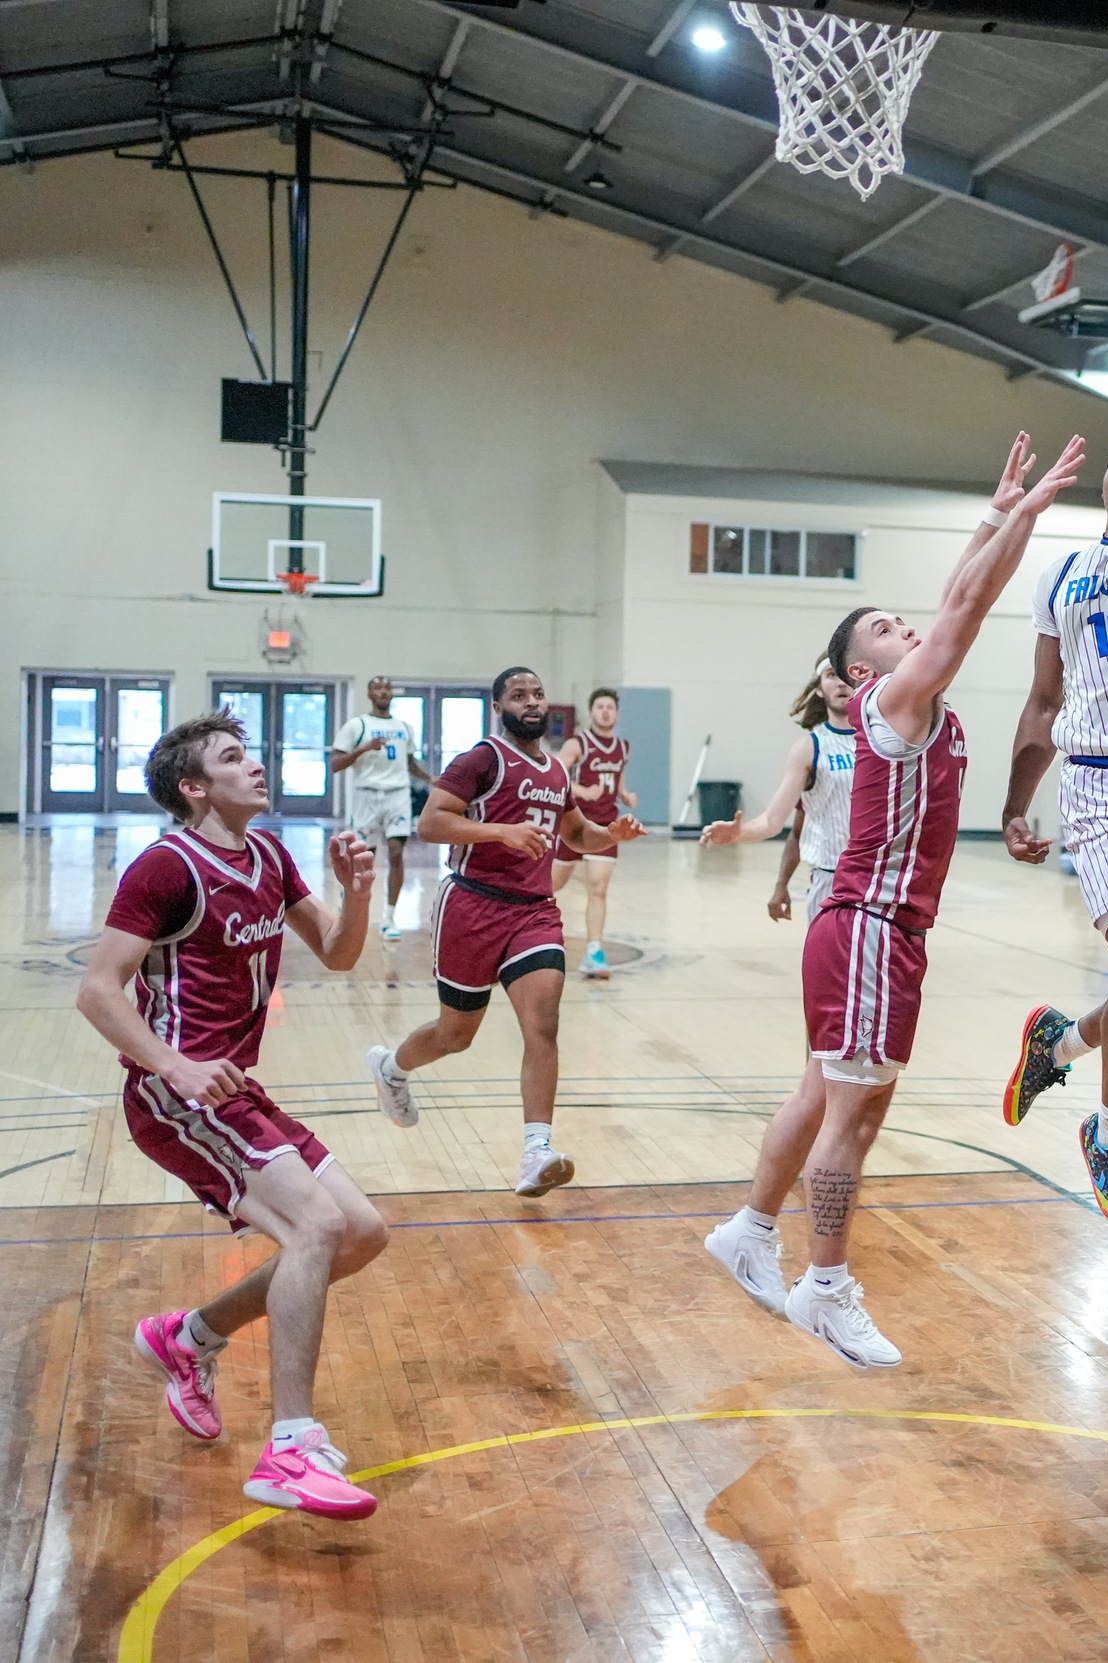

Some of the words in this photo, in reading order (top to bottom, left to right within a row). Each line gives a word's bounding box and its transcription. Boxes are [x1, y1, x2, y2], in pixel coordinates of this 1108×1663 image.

[387, 745, 396, 760] 0
[590, 757, 622, 773] Central
[518, 778, 565, 807] Central
[598, 773, 615, 795] 14
[223, 899, 285, 947] Central
[248, 949, 271, 1011] 11
